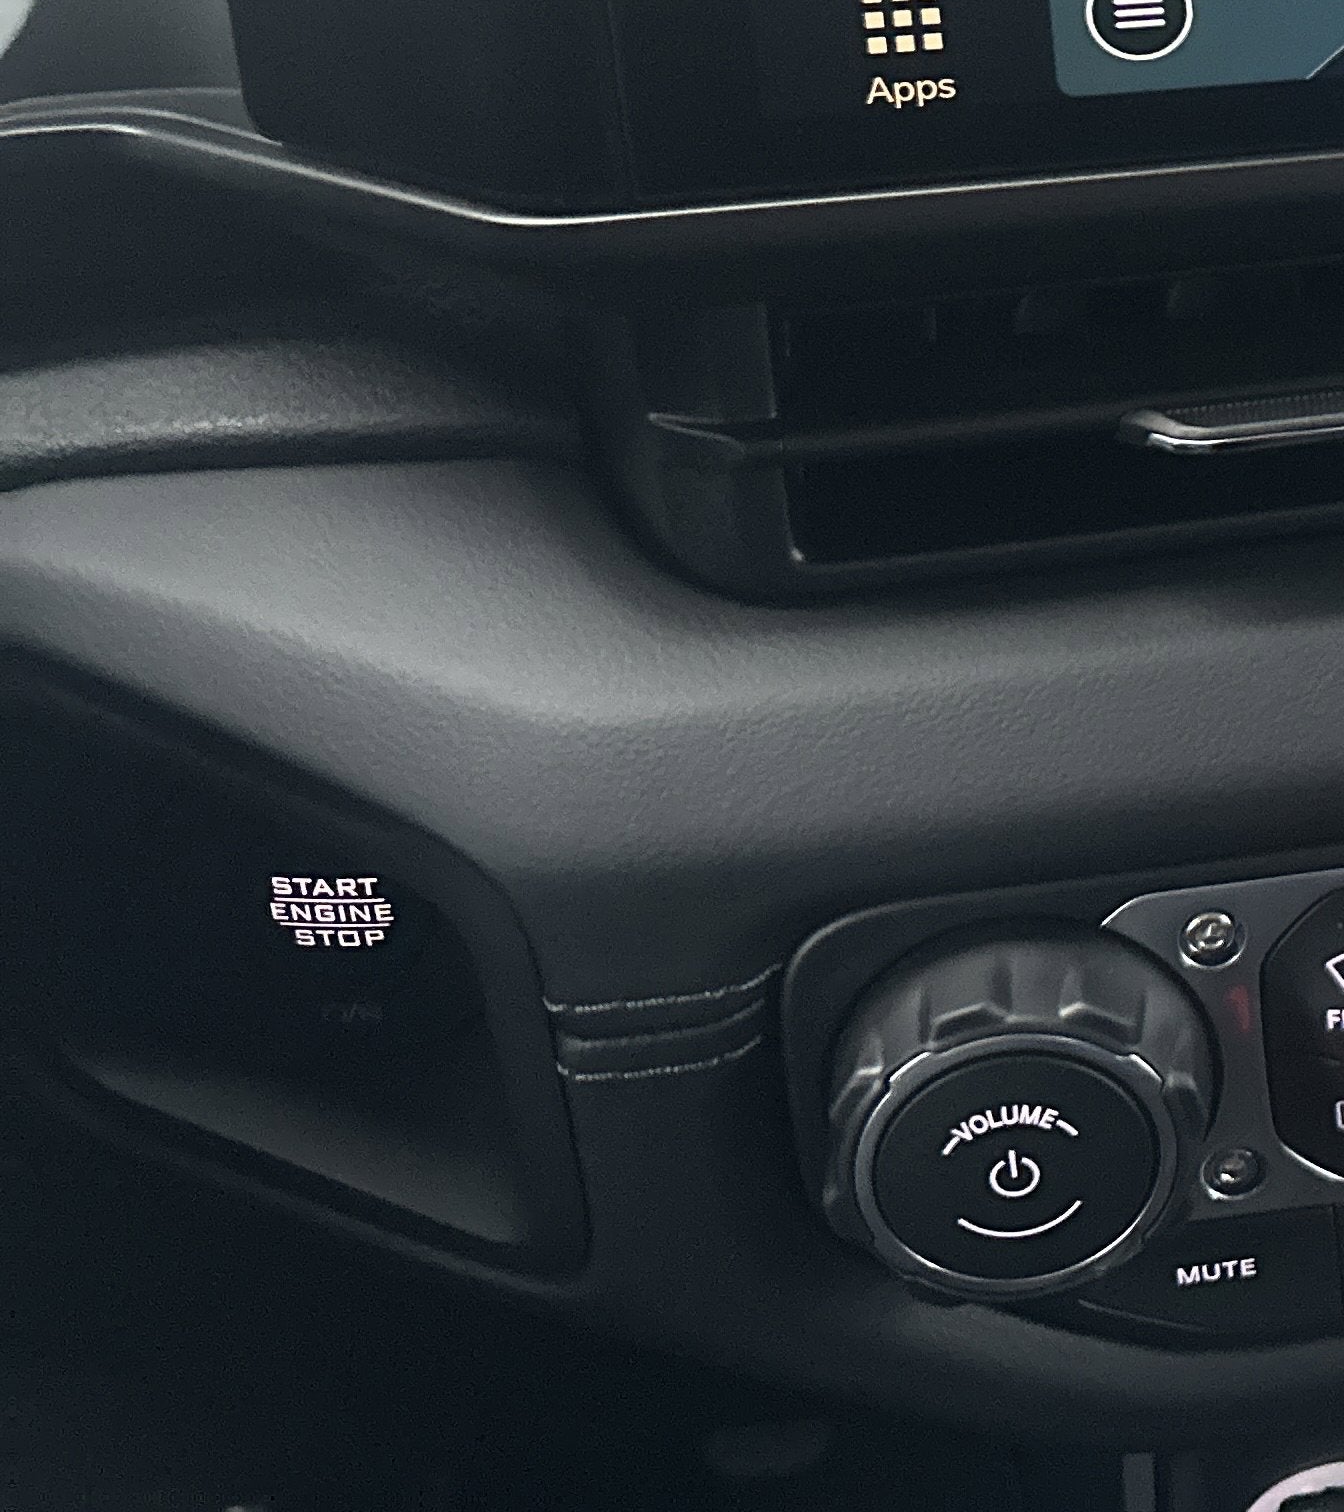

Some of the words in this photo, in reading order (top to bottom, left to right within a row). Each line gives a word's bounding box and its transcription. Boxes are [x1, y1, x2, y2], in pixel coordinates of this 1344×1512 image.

[867, 77, 956, 108] Apps
[271, 877, 378, 896] START
[270, 902, 394, 923] ENGINE
[295, 929, 385, 947] STOP
[955, 1104, 1058, 1143] VOLUME
[1177, 1258, 1256, 1284] MUTE
